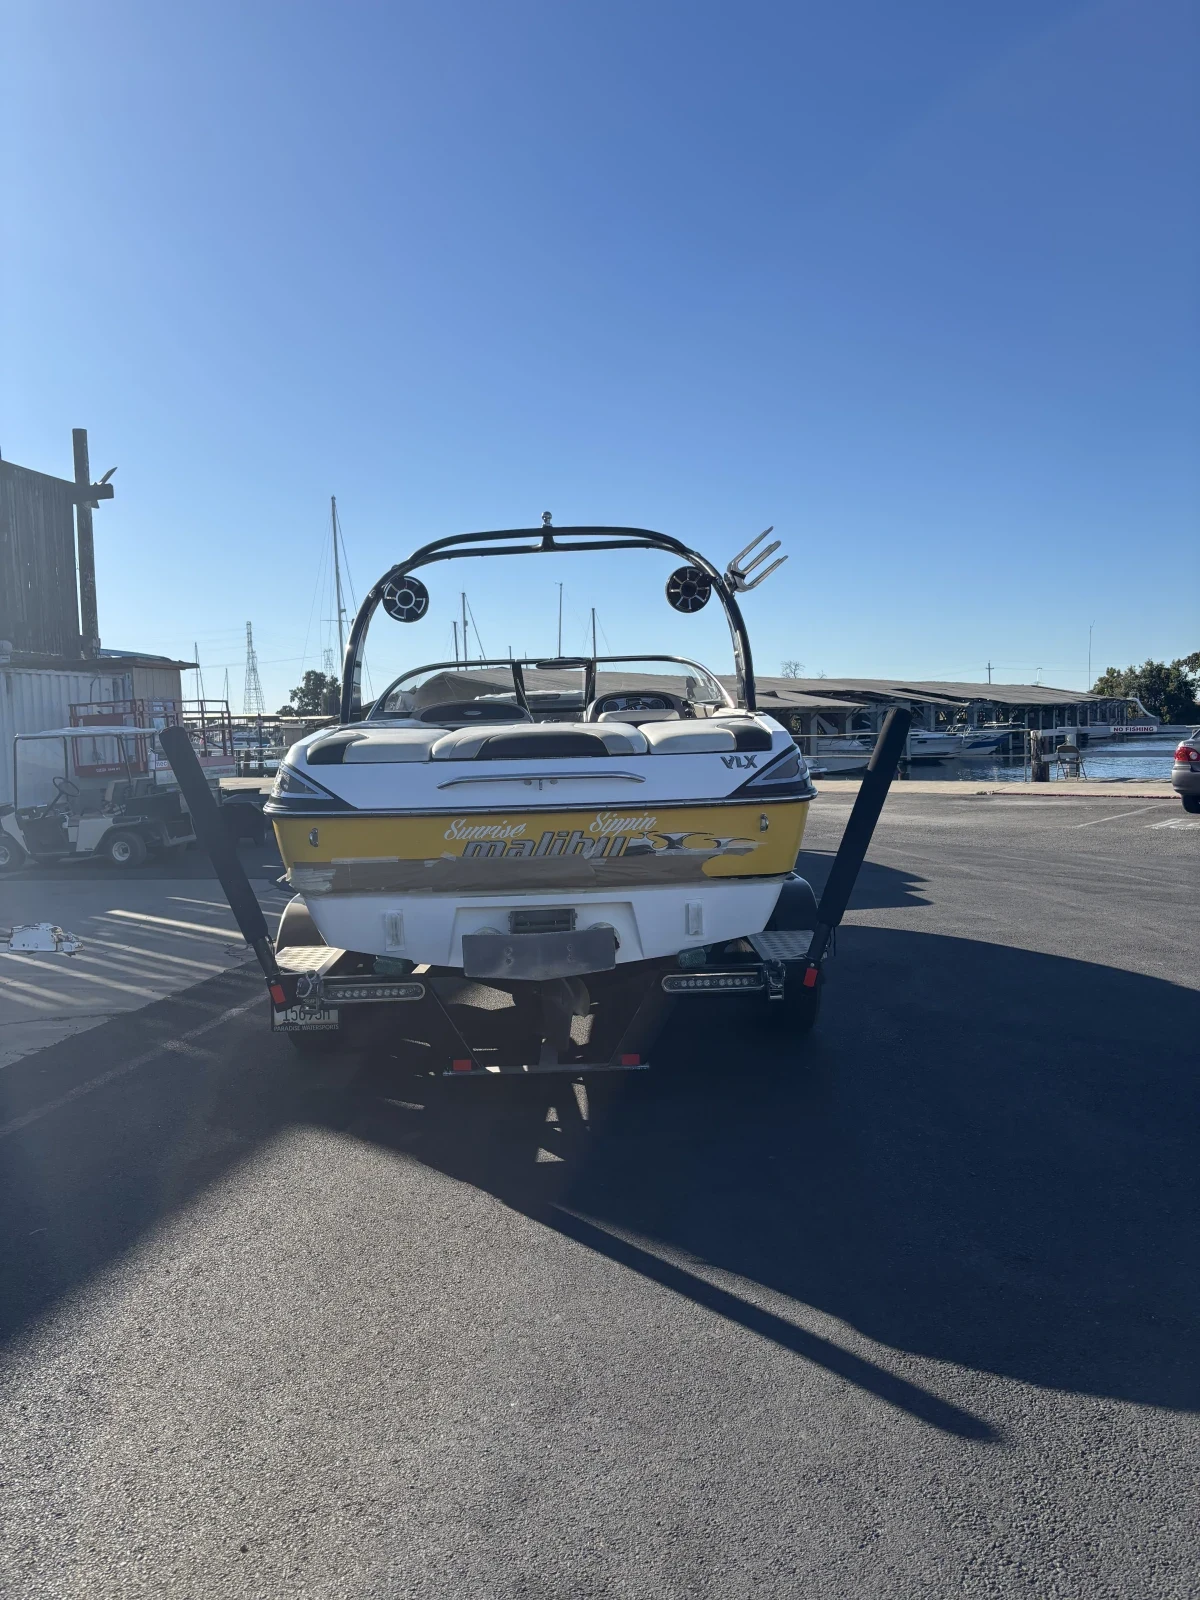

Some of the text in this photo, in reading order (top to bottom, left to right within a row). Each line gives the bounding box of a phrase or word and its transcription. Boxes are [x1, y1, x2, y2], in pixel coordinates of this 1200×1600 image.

[720, 754, 758, 770] VLX
[443, 811, 658, 841] Sunrise Sippin
[301, 1023, 339, 1031] WATERSPORTS
